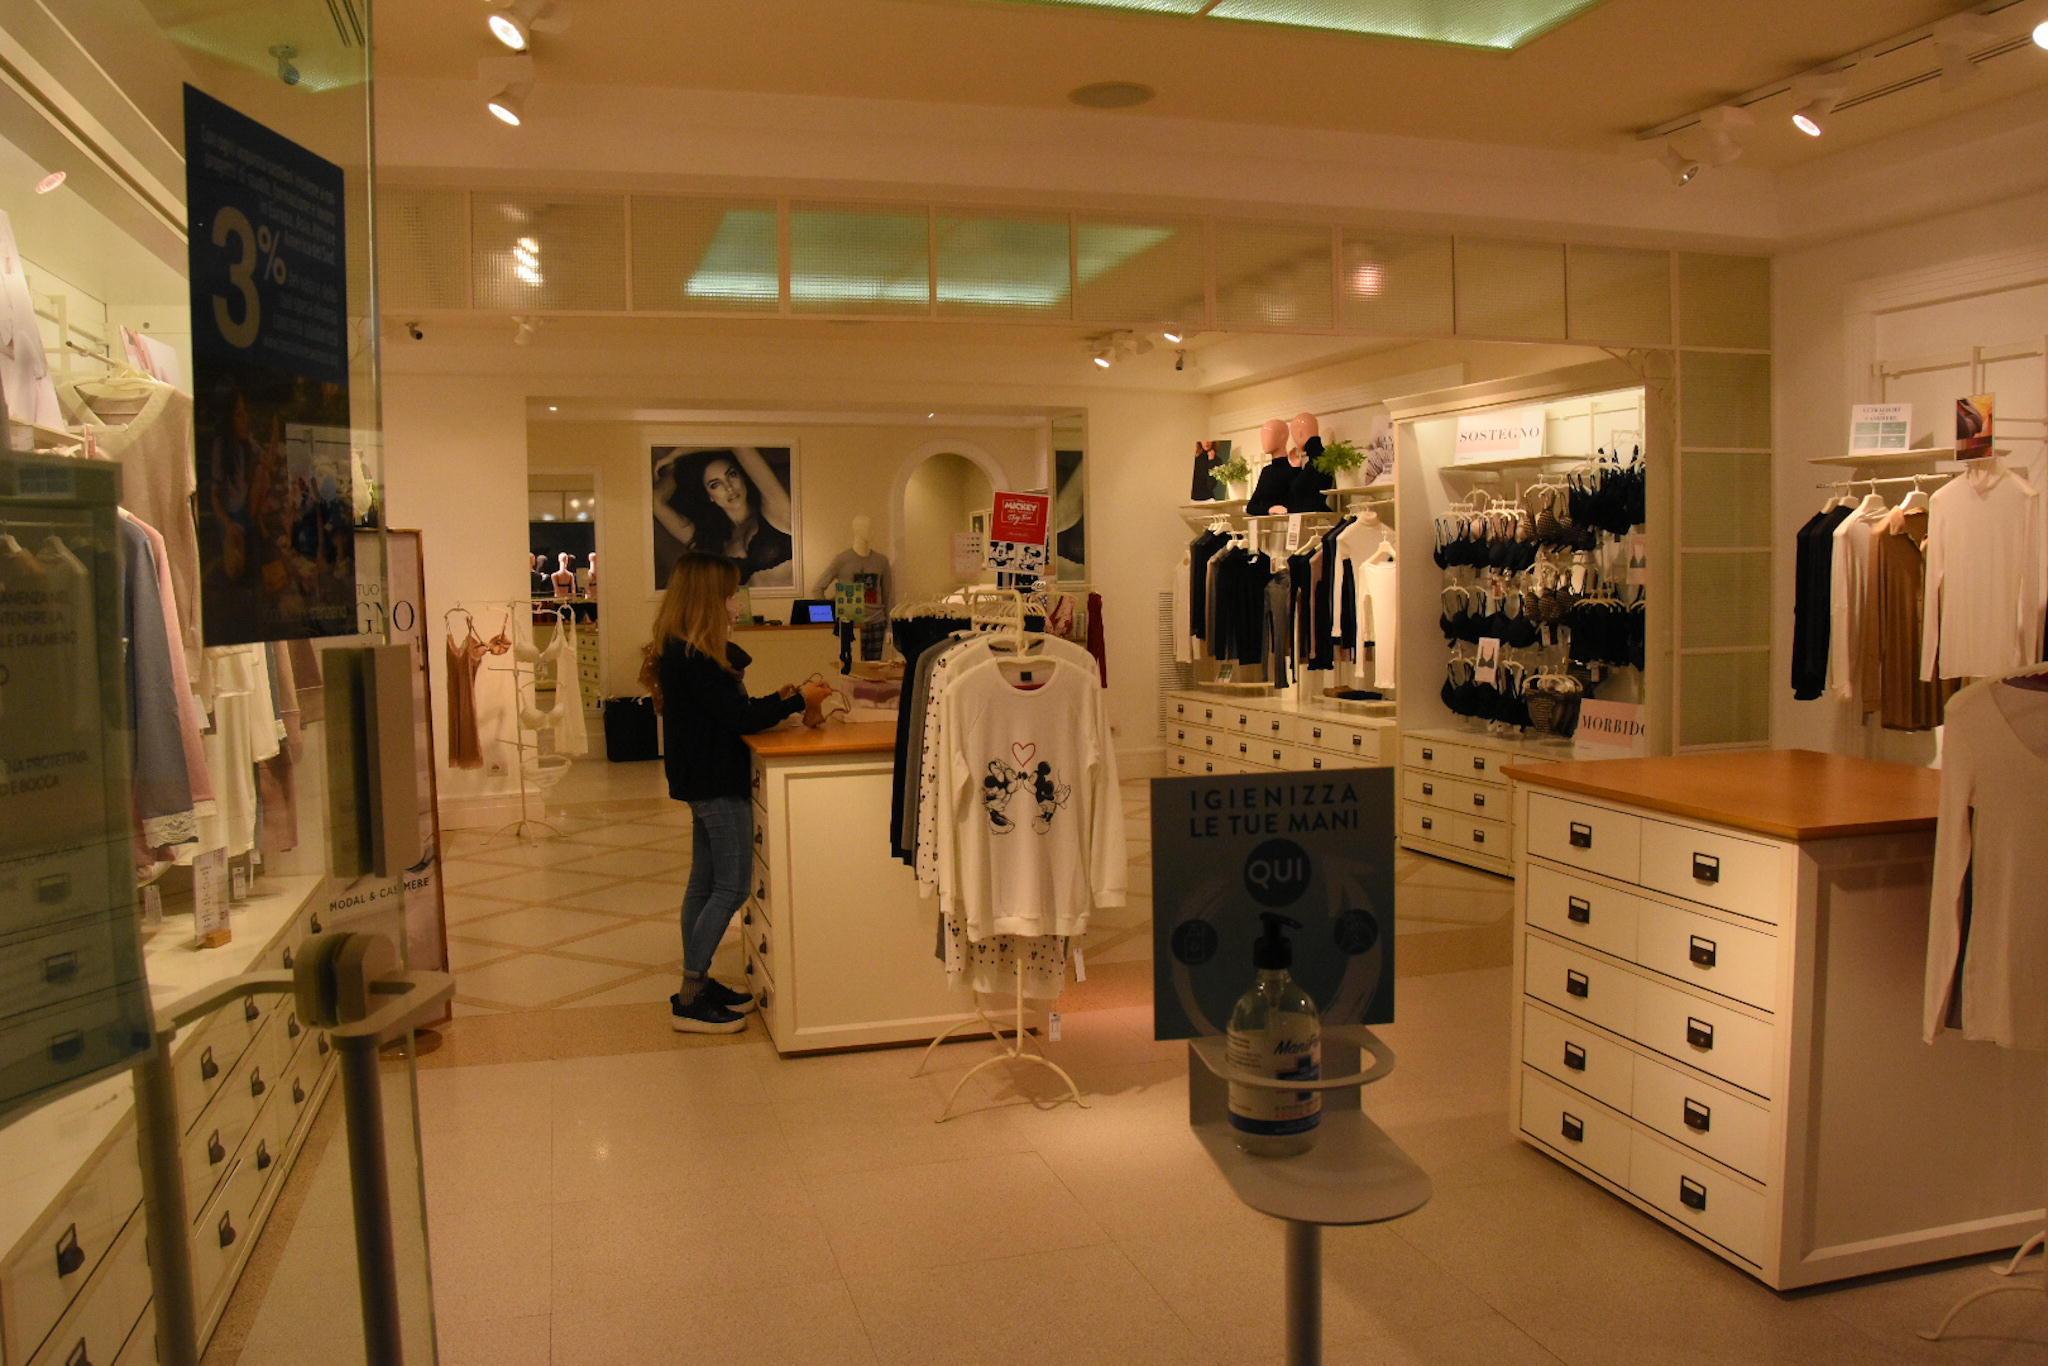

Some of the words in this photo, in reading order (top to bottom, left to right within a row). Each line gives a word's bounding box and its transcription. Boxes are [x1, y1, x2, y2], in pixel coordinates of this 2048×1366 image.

[1459, 425, 1540, 442] SOSTEGNO
[1004, 502, 1037, 512] MICKEY
[19, 773, 59, 794] BOCCA
[1190, 783, 1358, 811] IGIENIZZA
[1190, 816, 1219, 838] LE
[1228, 814, 1278, 836] TUE
[1288, 809, 1359, 833] MANI
[1248, 857, 1303, 889] QUI
[329, 895, 366, 912] MODAL
[369, 892, 376, 902] &
[380, 877, 429, 898] CASMERE
